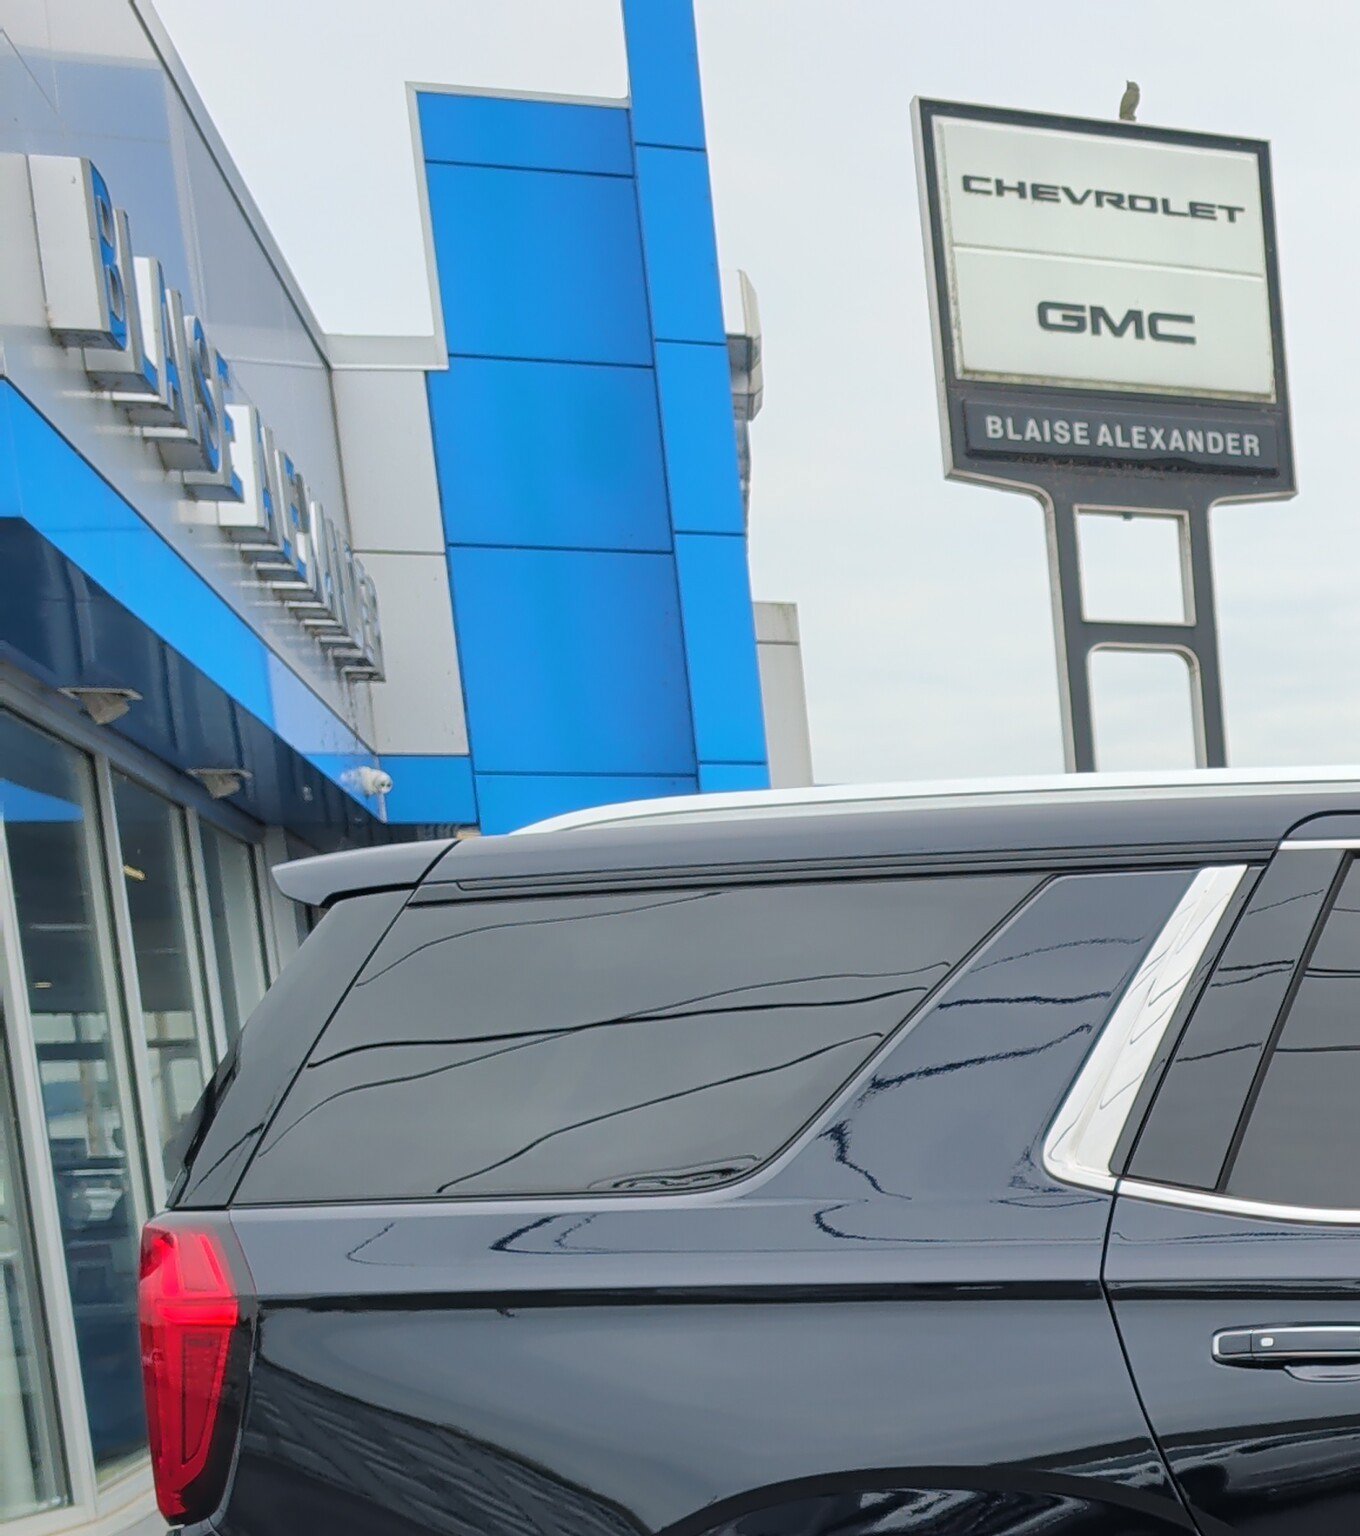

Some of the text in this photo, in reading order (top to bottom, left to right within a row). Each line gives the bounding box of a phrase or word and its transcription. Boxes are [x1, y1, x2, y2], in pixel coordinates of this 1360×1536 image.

[962, 174, 1245, 223] CHEVROLET
[1037, 300, 1196, 345] GMC
[985, 415, 1261, 457] BLAISE ALEXANDER
